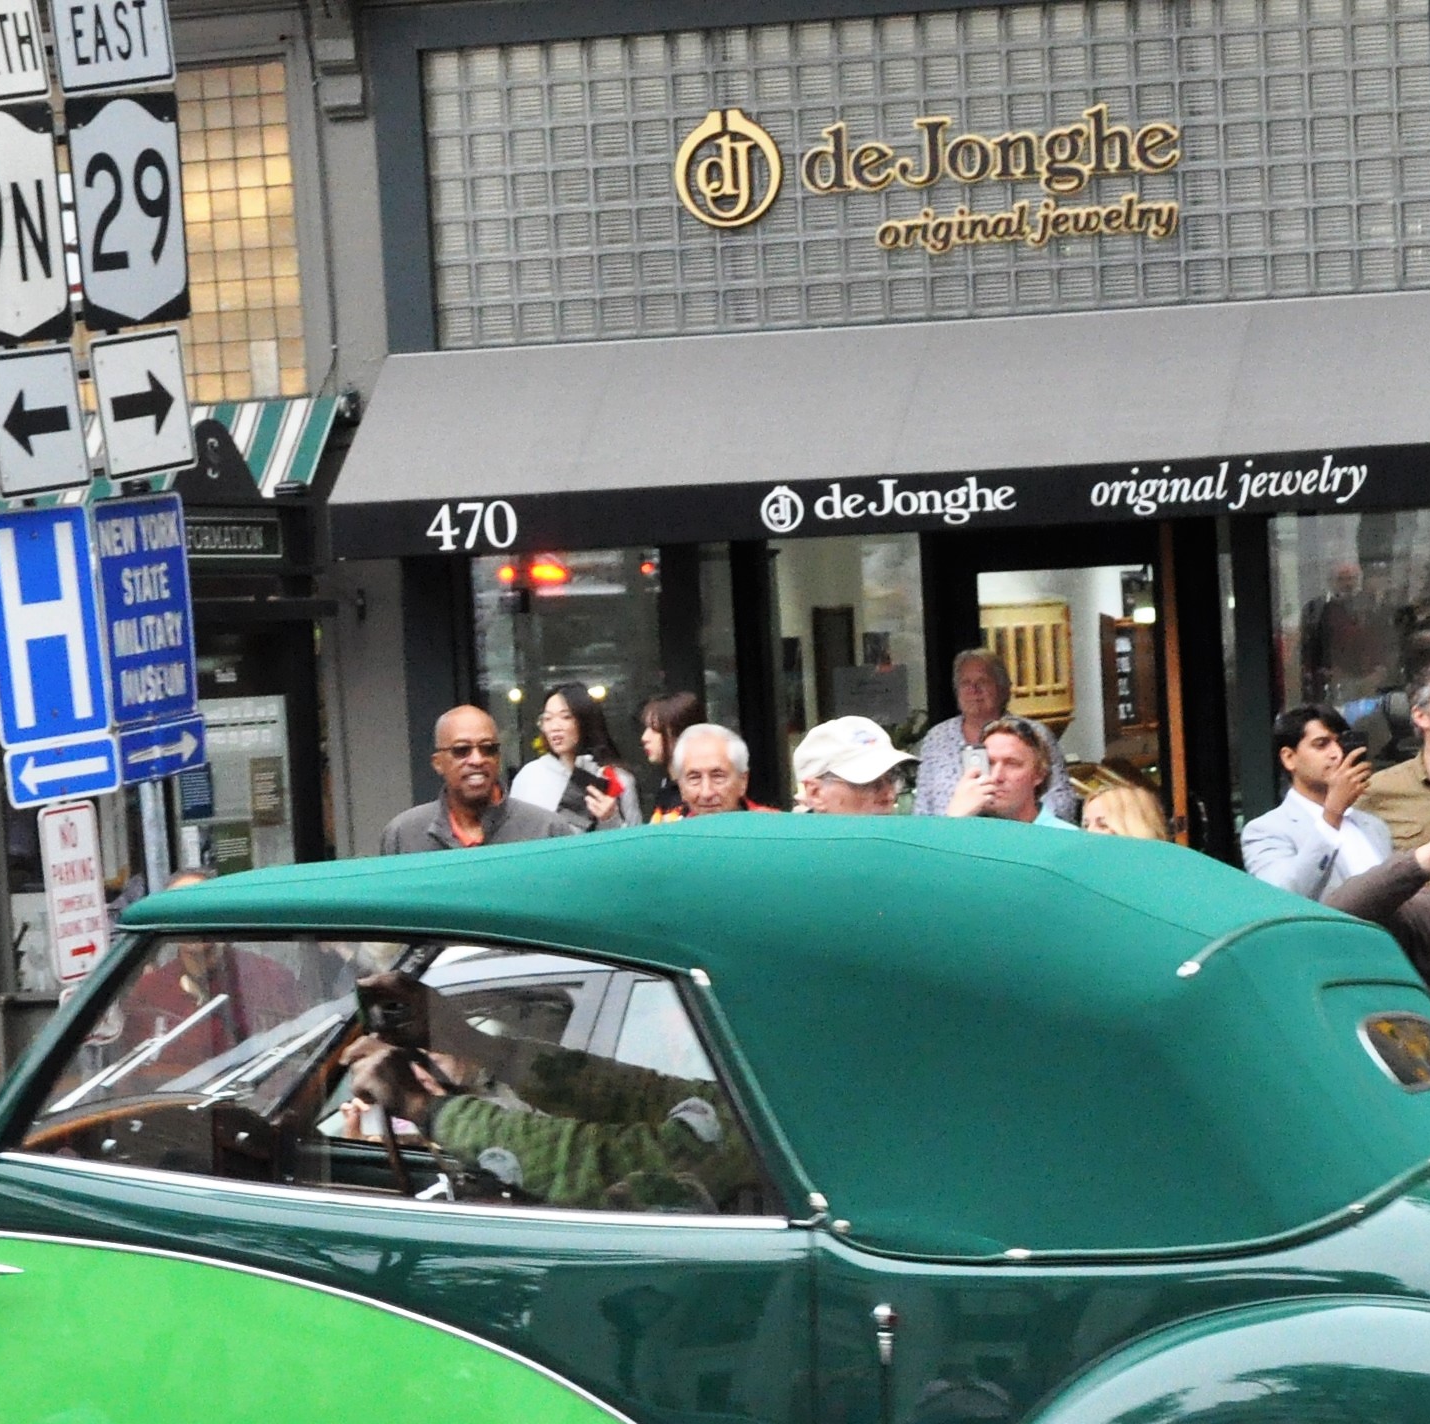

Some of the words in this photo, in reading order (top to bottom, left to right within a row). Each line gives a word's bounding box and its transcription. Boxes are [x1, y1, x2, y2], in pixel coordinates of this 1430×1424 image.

[70, 1, 148, 65] EAST
[85, 148, 169, 273] 29
[875, 199, 1036, 254] original
[1030, 192, 1179, 246] jewelry
[426, 500, 517, 550] 470
[1090, 461, 1229, 516] original
[1228, 455, 1368, 510] jewelry
[98, 516, 137, 558] NEW
[138, 510, 181, 551] YORK
[186, 525, 264, 549] FORMATION
[122, 562, 171, 605] STATE
[113, 610, 183, 658] MILITARY
[121, 662, 187, 707] MUSEUM
